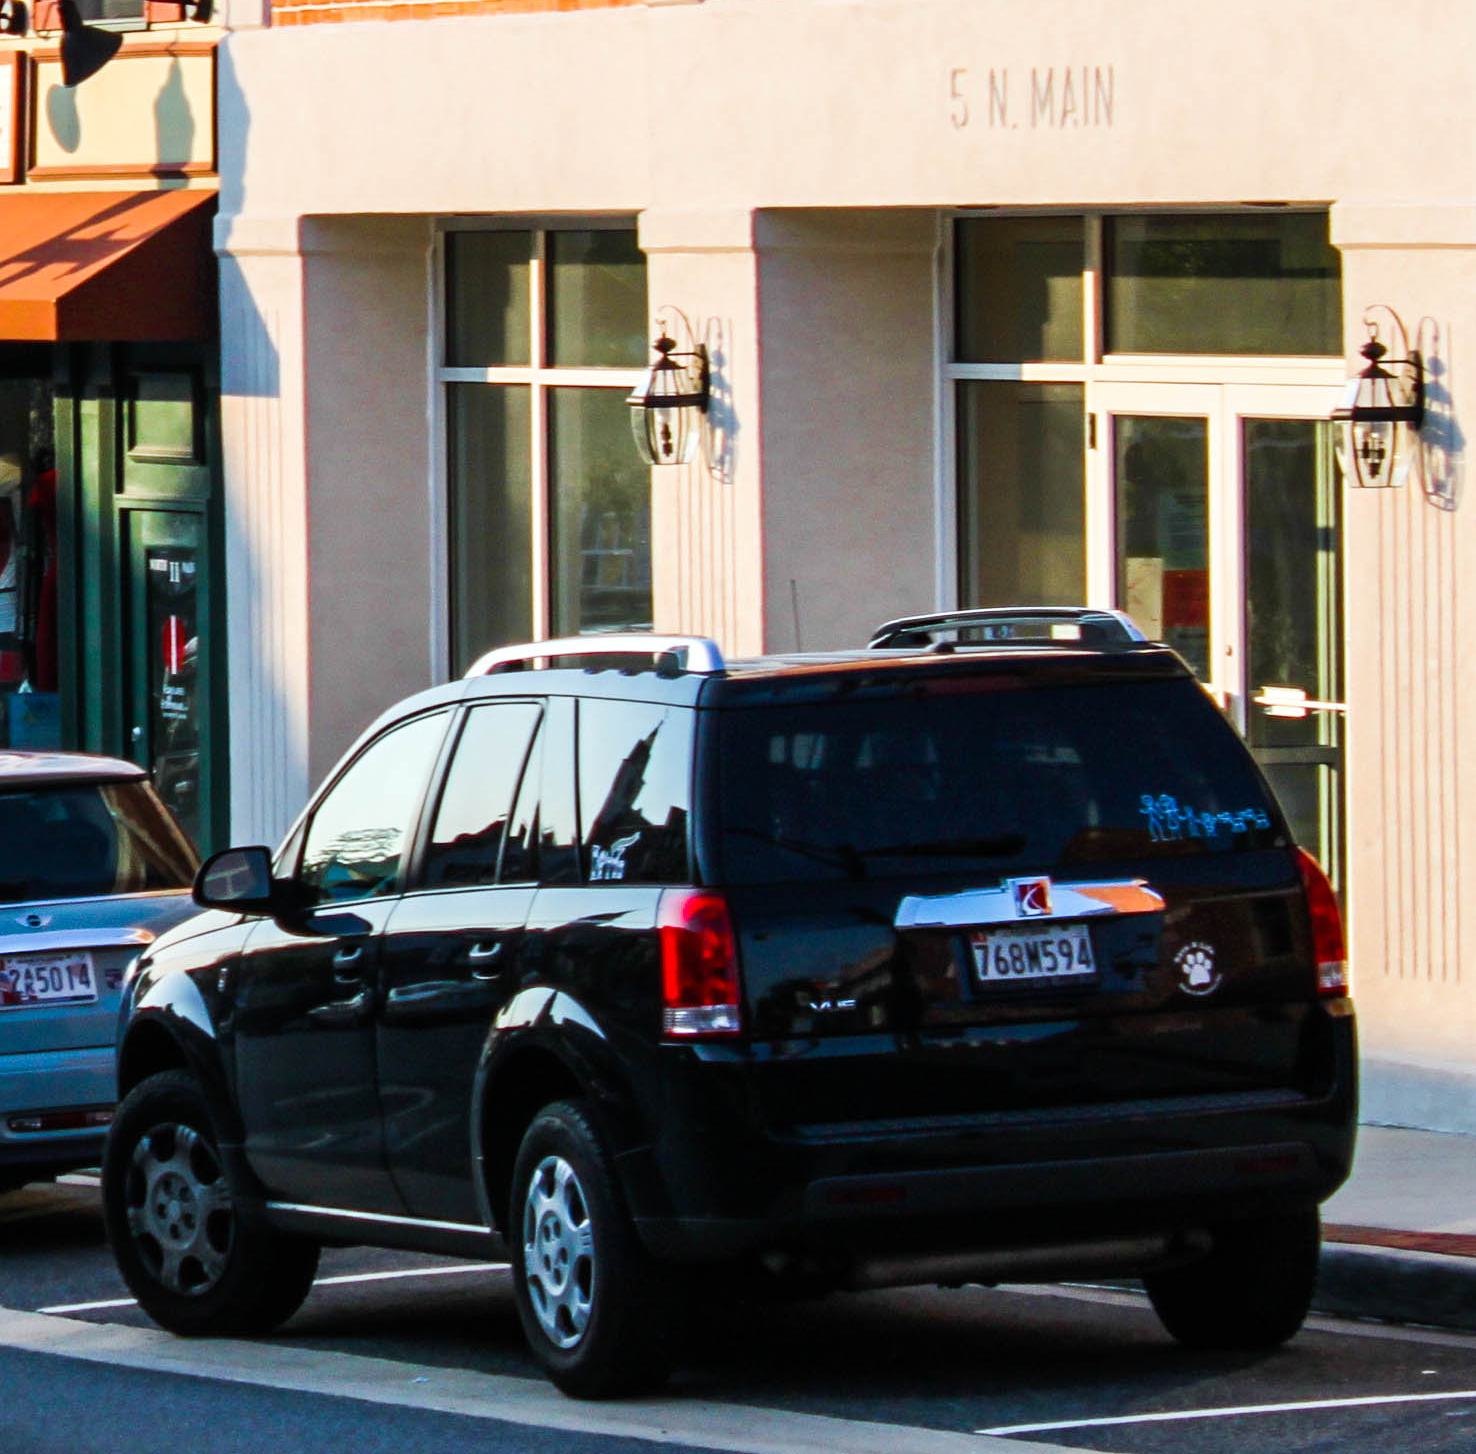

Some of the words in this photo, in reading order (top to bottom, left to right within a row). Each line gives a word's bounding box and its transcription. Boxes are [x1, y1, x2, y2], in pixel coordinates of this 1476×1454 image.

[951, 68, 969, 129] 5
[988, 67, 1019, 129] N.
[1031, 63, 1114, 129] MAIN
